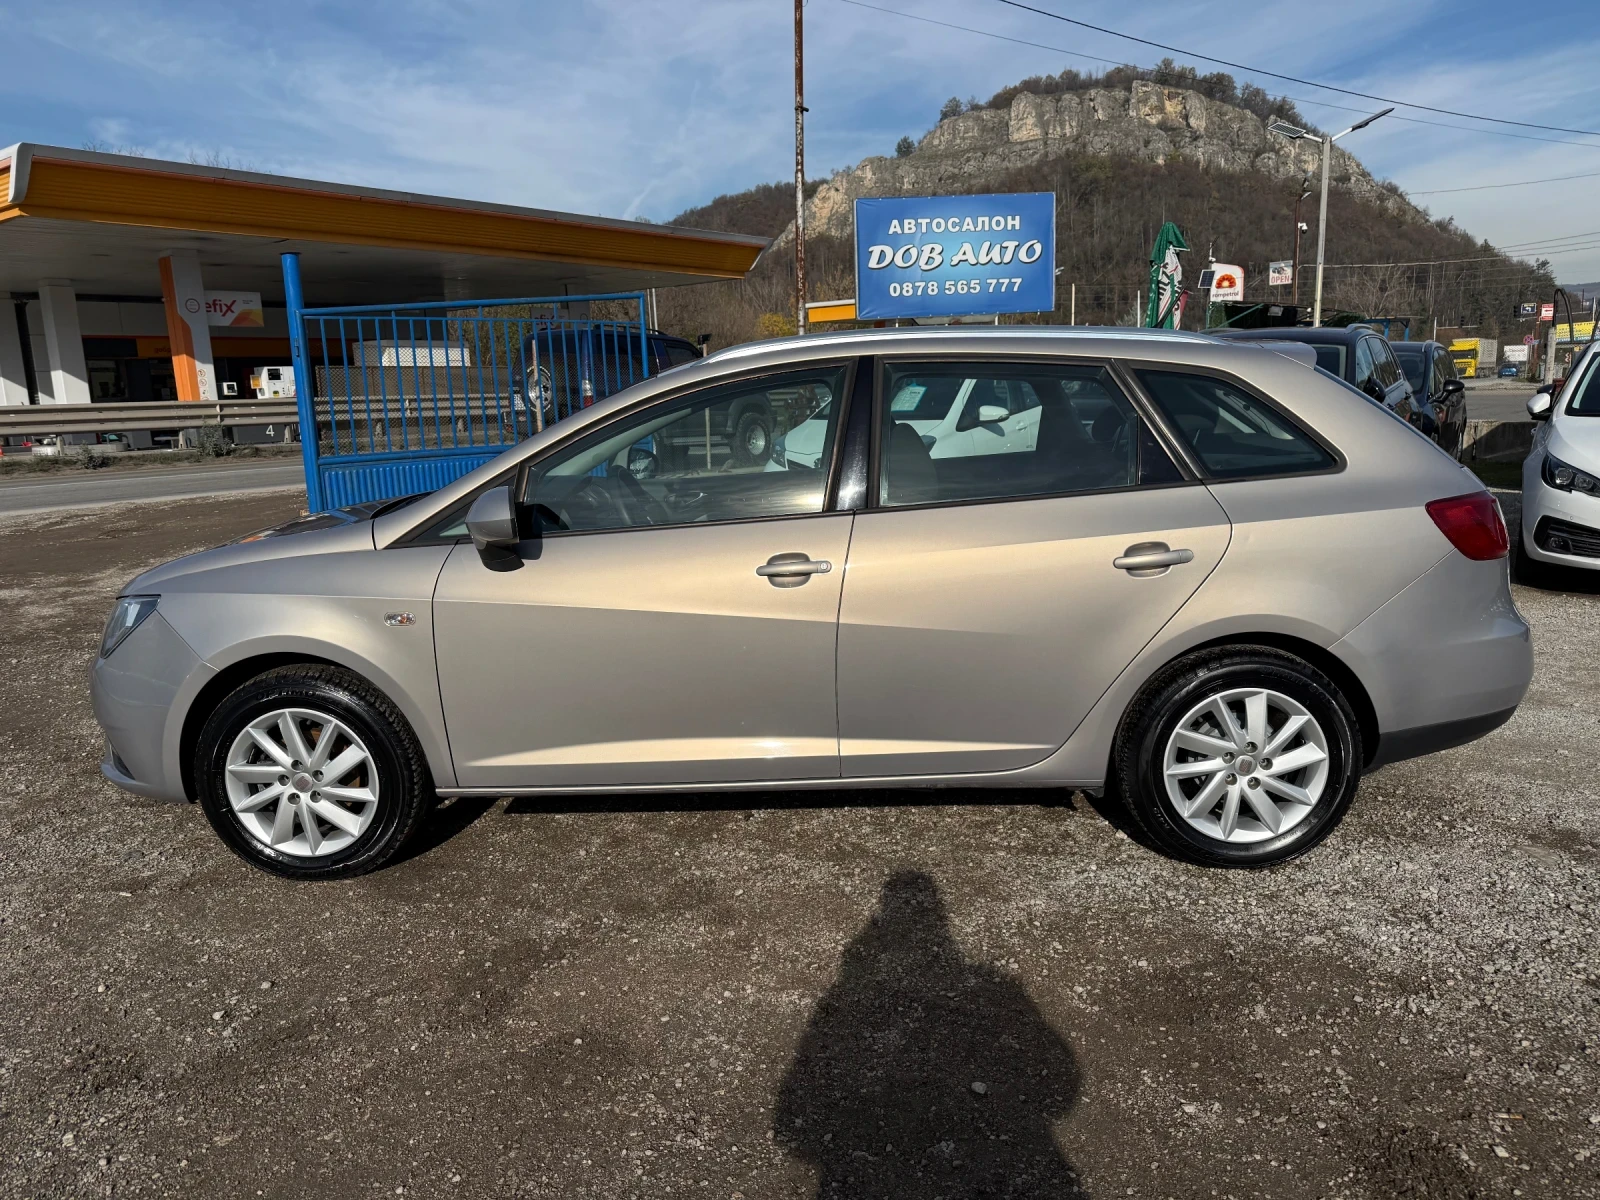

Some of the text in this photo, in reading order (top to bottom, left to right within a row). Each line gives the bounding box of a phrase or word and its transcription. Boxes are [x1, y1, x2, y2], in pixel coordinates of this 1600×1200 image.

[888, 215, 1021, 235] АВТОСАЛОН
[867, 239, 1043, 271] DOB AUTO
[889, 277, 1023, 297] 0878 565 777
[1270, 275, 1290, 284] OPEN
[1212, 290, 1240, 299] rompetrol
[205, 298, 237, 317] efix
[265, 424, 275, 437] 4
